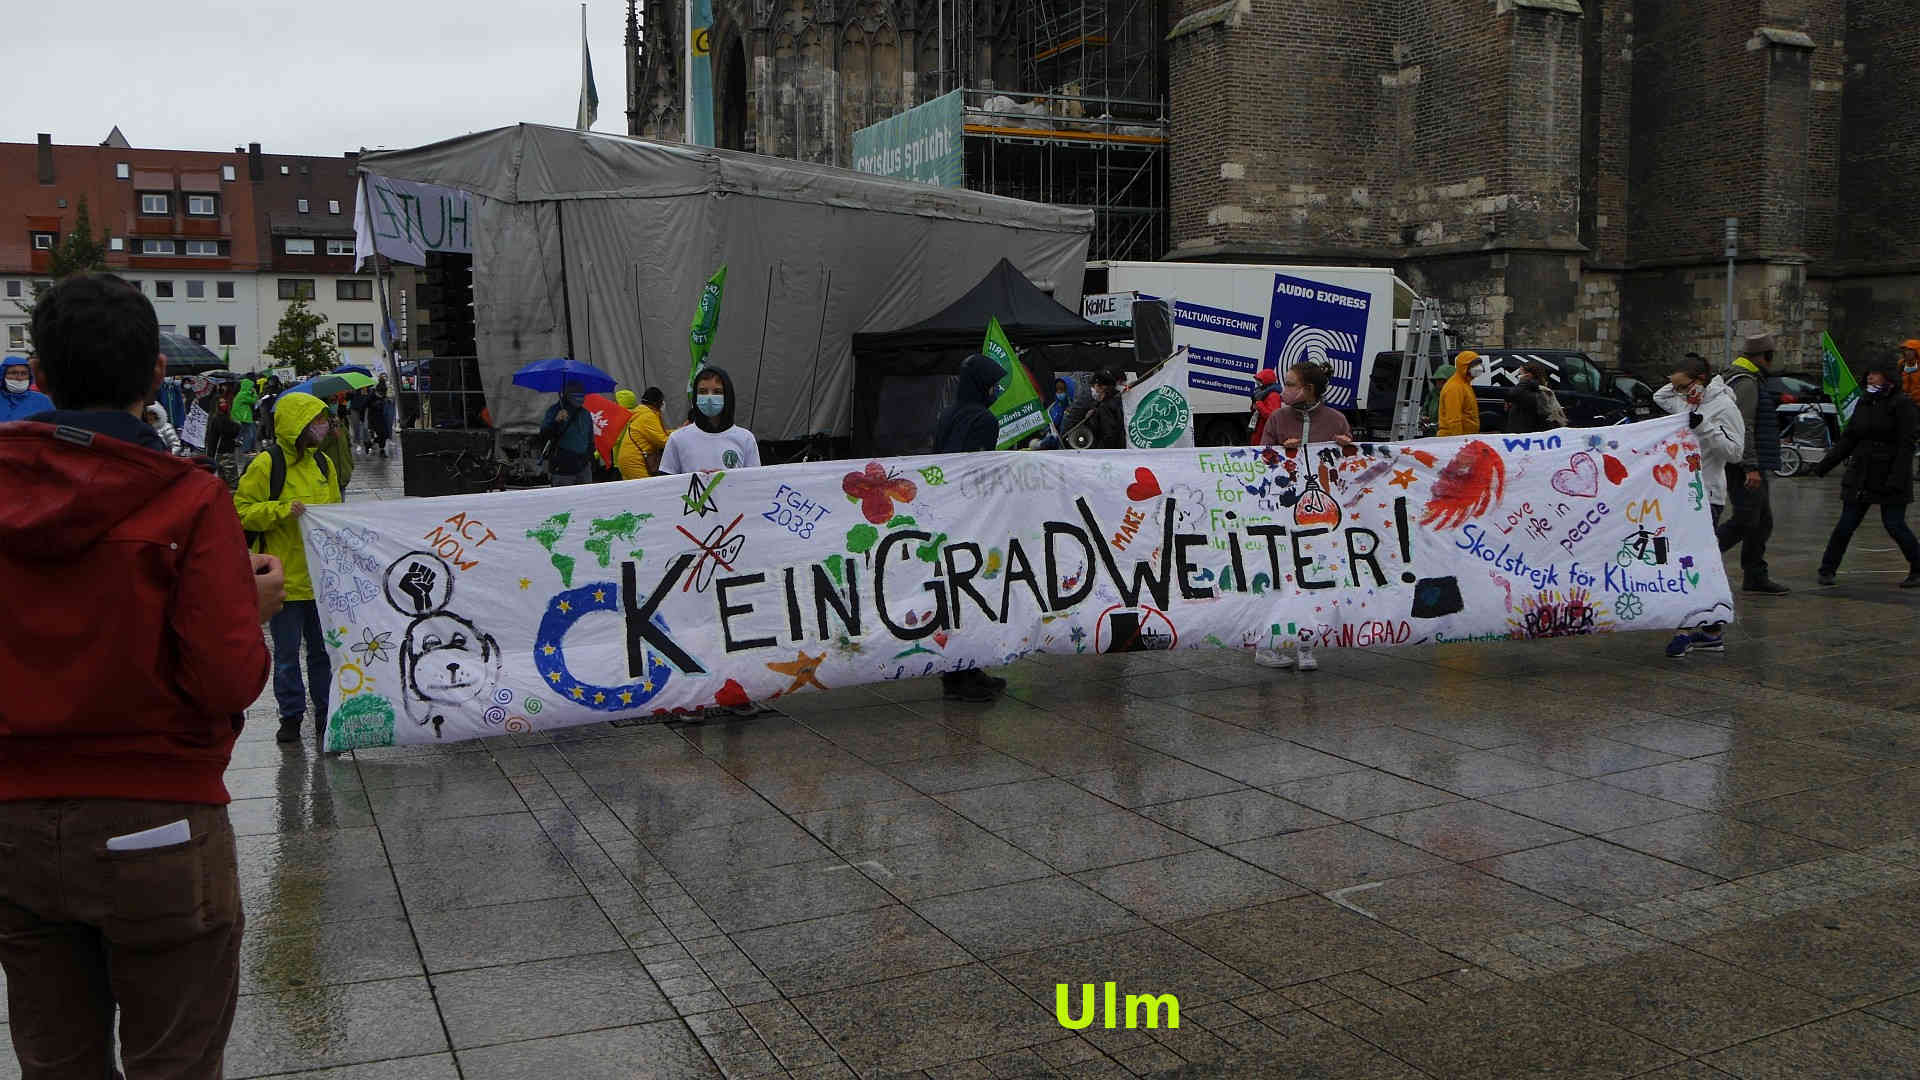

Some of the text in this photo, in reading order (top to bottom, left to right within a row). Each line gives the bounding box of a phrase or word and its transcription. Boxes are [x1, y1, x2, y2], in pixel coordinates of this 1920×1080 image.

[857, 146, 901, 176] Christus
[1277, 283, 1367, 310] AUDIO EXPRESS
[1199, 453, 1267, 483] Fridays
[775, 484, 831, 522] FGHT
[1216, 479, 1244, 504] for
[444, 511, 497, 547] ACT
[761, 502, 815, 540] 2038
[1111, 506, 1145, 551] MAKE
[1495, 502, 1533, 535] Love
[1525, 503, 1570, 542] life in
[1626, 499, 1663, 523] CM
[423, 526, 480, 571] NOW
[1560, 502, 1610, 559] peace
[1456, 519, 1689, 595] Skolstrejk för Klimatet
